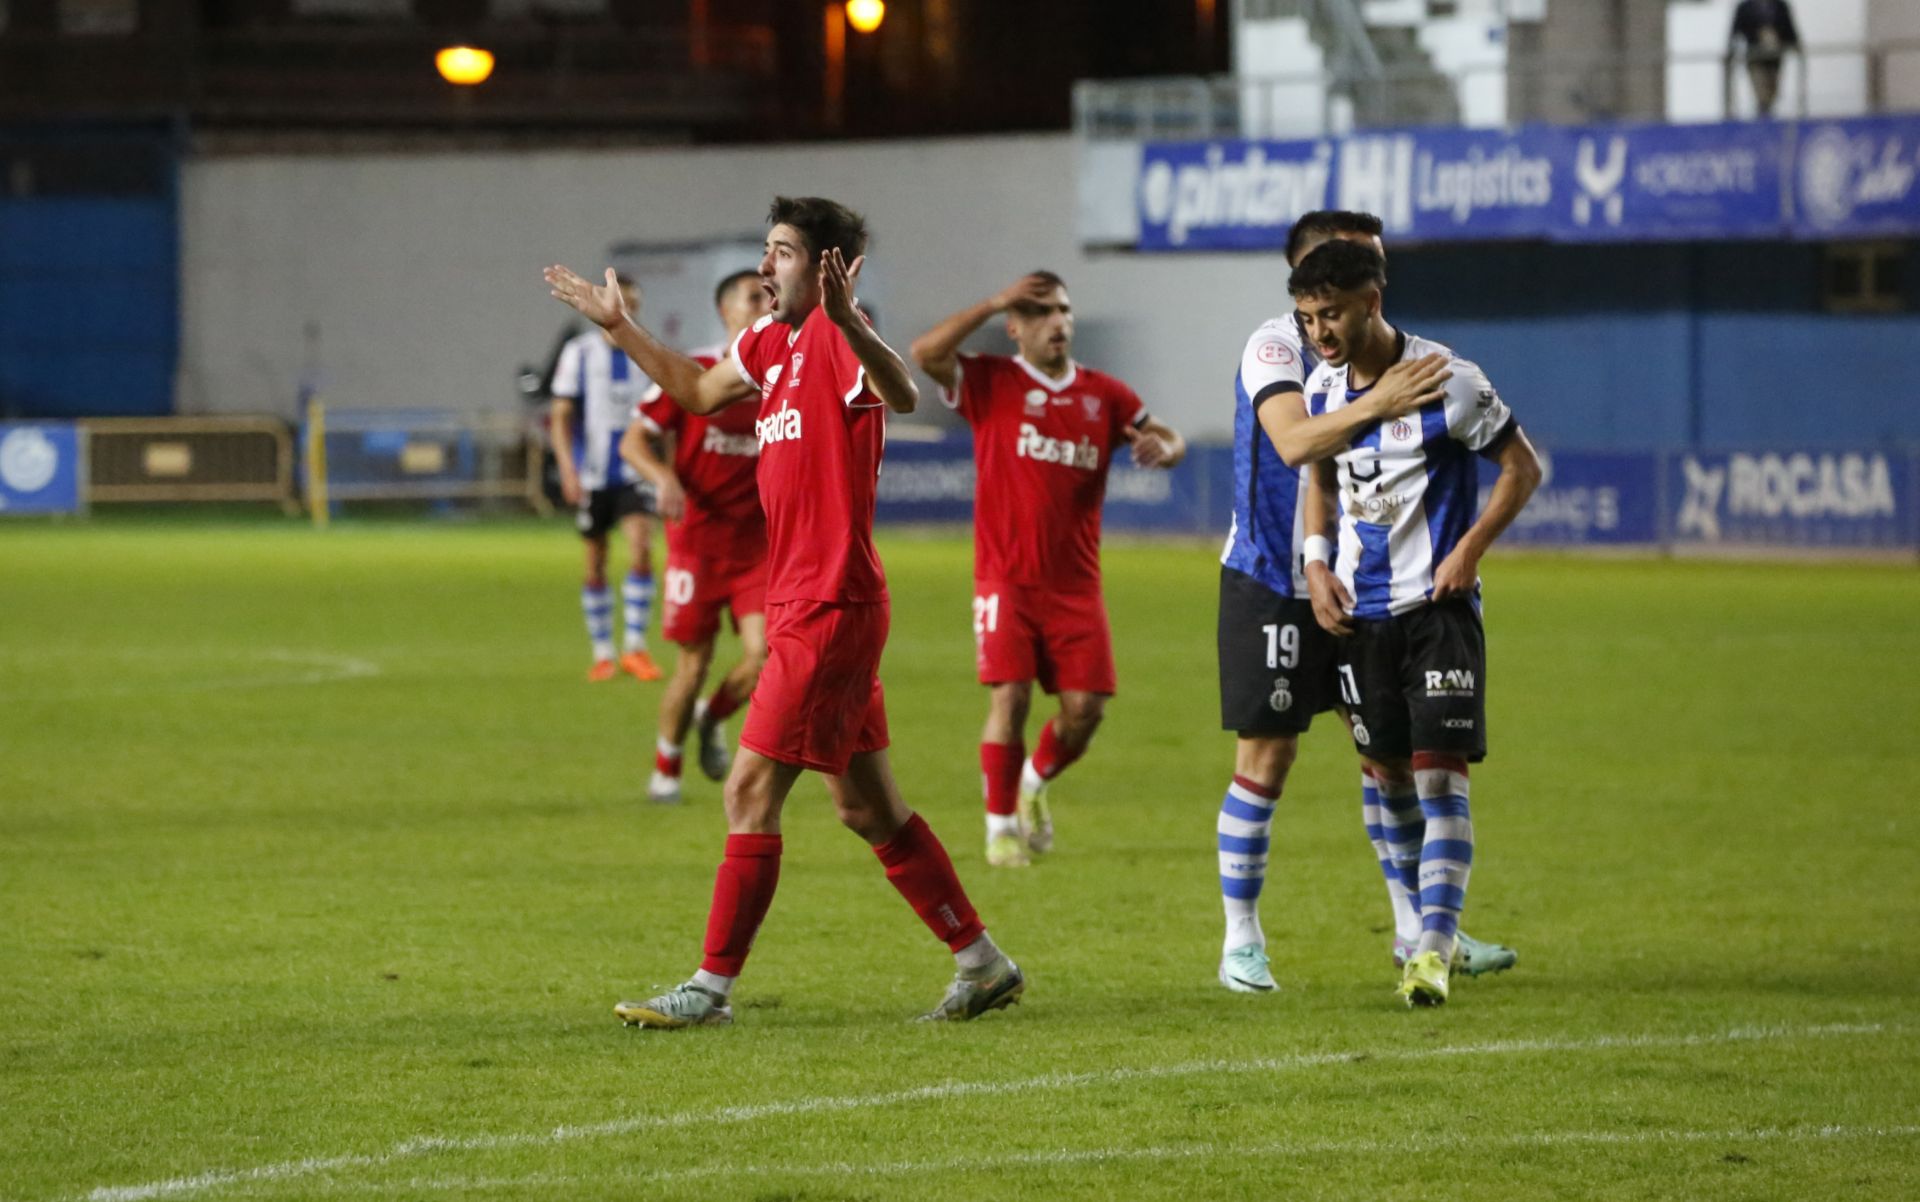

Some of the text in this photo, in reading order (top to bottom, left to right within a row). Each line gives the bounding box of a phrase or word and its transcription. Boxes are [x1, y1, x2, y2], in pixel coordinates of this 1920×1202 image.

[1417, 146, 1552, 224] Logistics
[1016, 421, 1100, 471] Posada
[1727, 452, 1897, 518] ROCASA
[665, 566, 695, 606] 10
[972, 593, 998, 633] 21
[1262, 623, 1300, 669] 19
[1424, 669, 1475, 690] RAW
